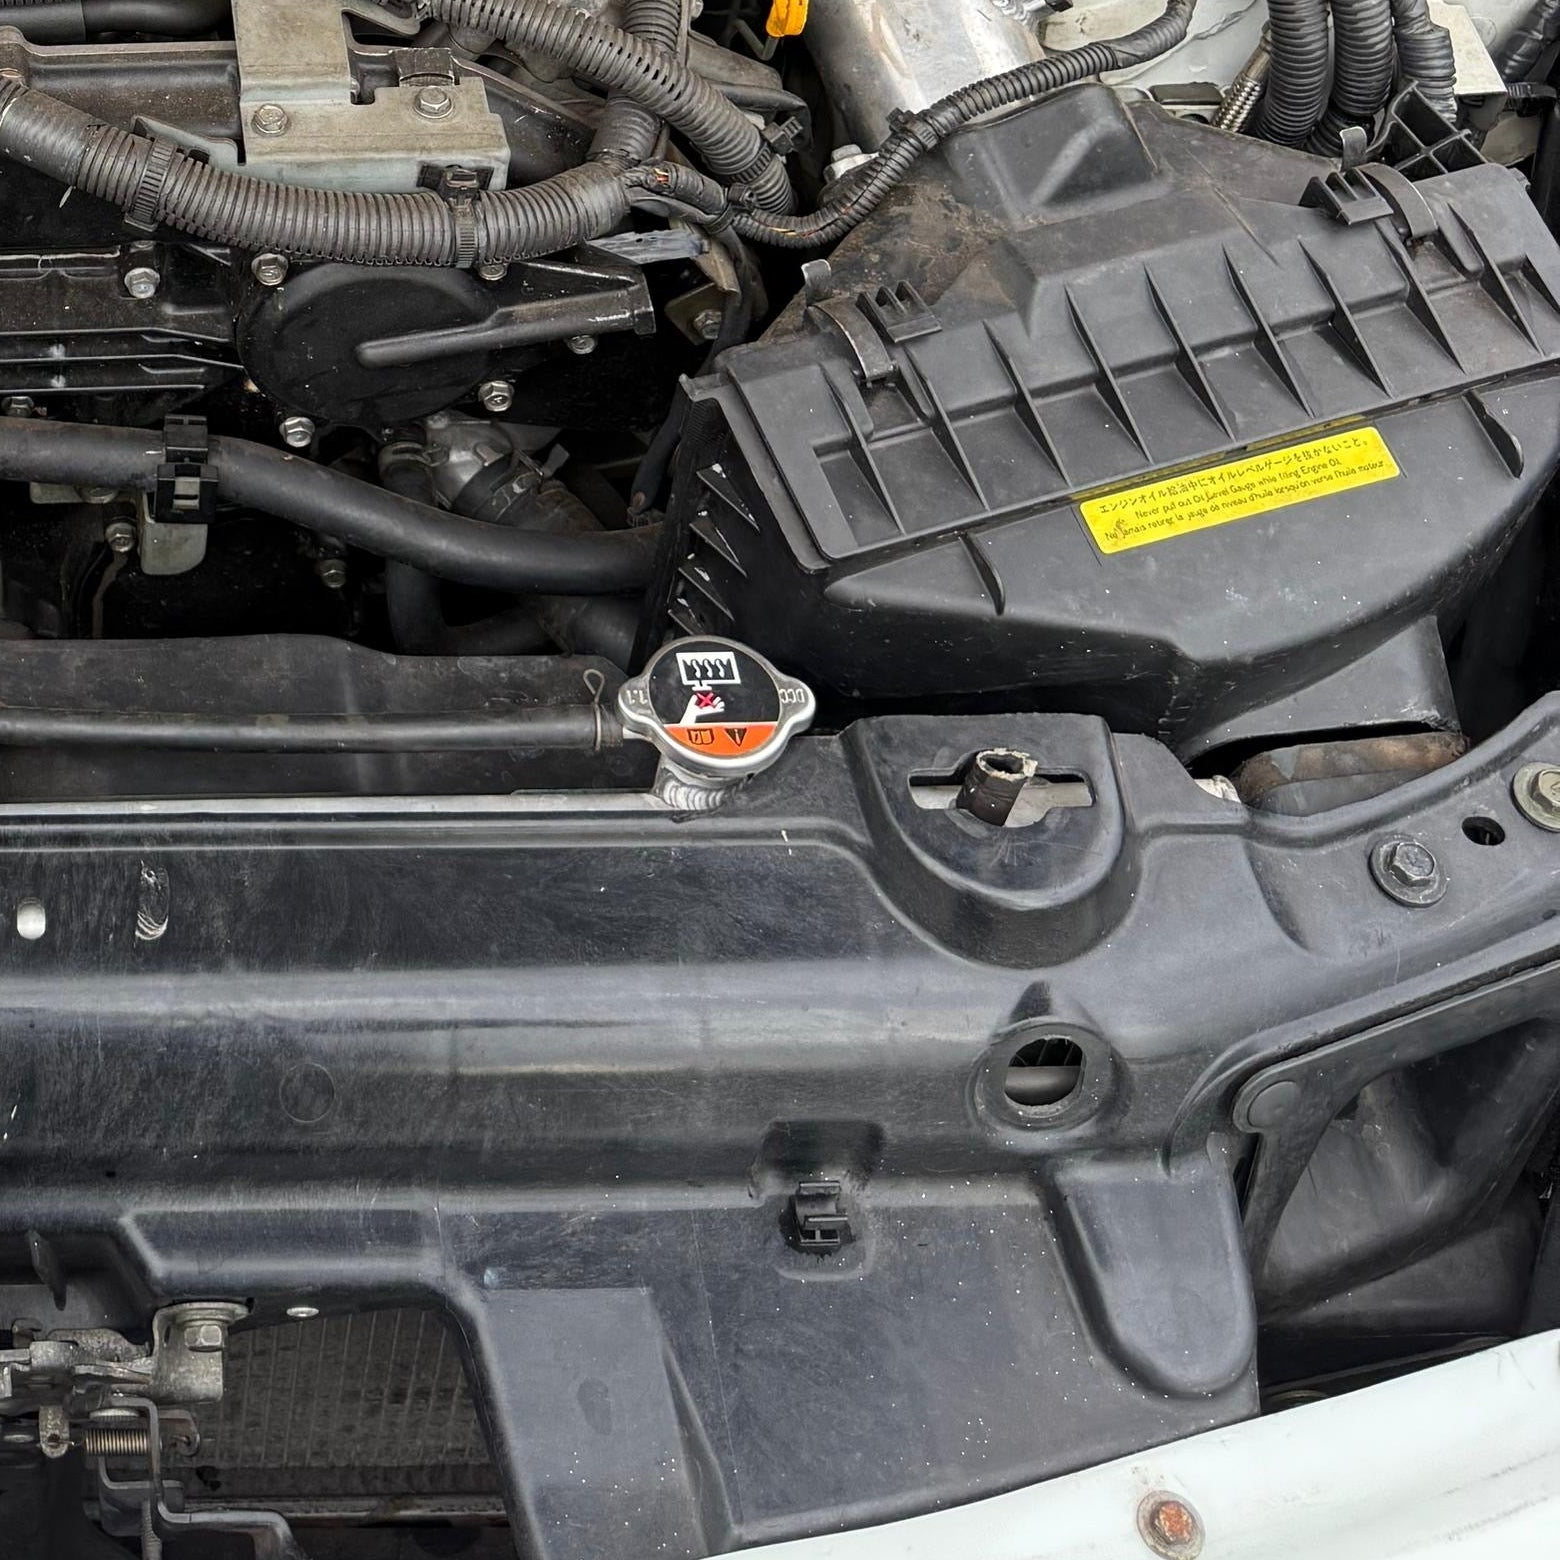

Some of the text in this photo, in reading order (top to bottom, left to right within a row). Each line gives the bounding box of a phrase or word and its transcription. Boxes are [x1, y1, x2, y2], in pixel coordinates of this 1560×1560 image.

[1134, 505, 1160, 518] Never
[1176, 497, 1192, 507] out
[1228, 480, 1257, 495] Gauge
[1299, 460, 1329, 476] Engine
